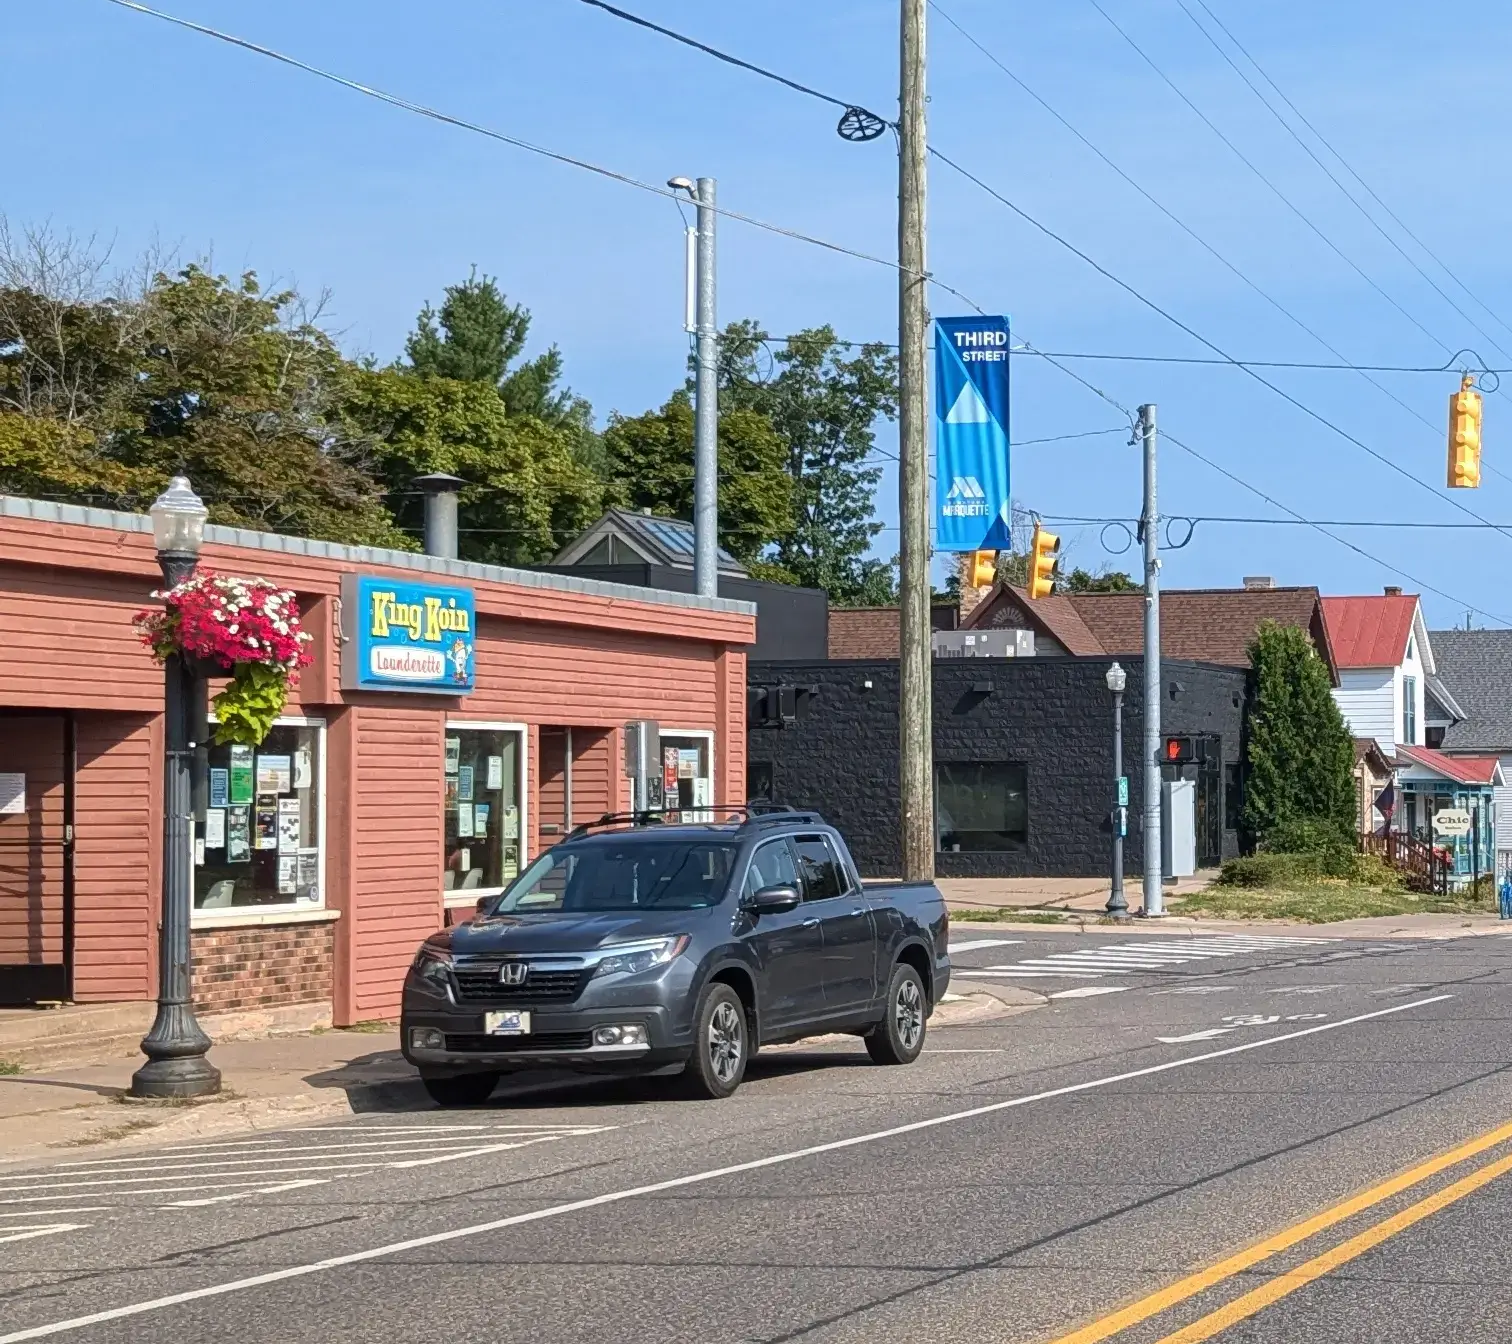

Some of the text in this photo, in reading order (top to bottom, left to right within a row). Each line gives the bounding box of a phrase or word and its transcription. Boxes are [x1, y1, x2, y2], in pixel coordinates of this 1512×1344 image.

[954, 331, 1007, 346] THIRD
[962, 350, 1007, 362] STREET
[371, 591, 470, 642] King Koin
[376, 650, 442, 674] Launderette
[1436, 816, 1470, 825] Chic
